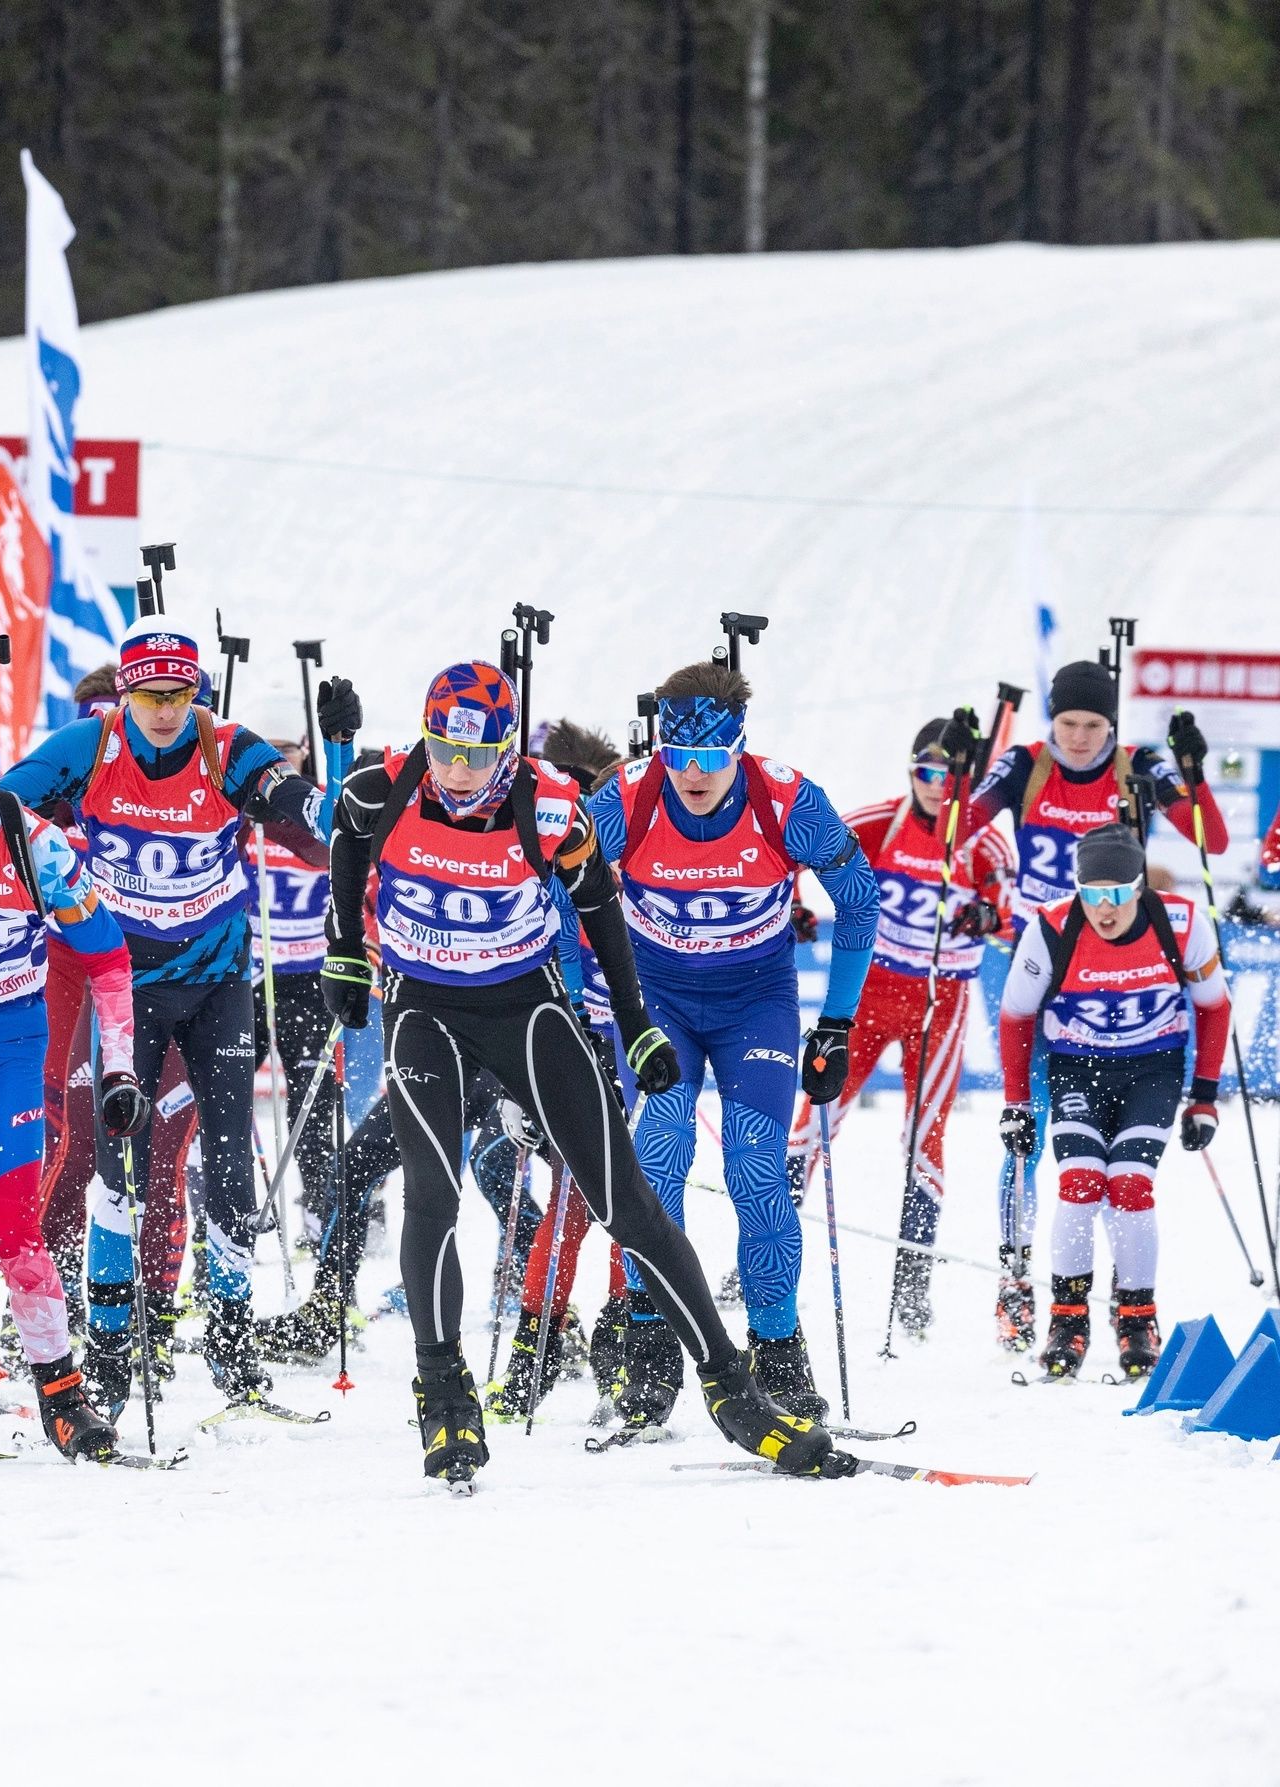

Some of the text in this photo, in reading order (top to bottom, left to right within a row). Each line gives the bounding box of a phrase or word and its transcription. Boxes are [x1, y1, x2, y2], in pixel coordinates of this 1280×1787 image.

[111, 796, 193, 822] Severstal
[537, 811, 567, 827] VEKA
[95, 830, 224, 880] 206
[408, 846, 509, 878] Severstal
[1030, 834, 1078, 881] 21
[113, 869, 148, 893] RYBU
[652, 861, 744, 881] Severstal
[257, 874, 321, 912] 17
[168, 908, 180, 918] &
[410, 921, 452, 948] RYBU
[674, 937, 710, 951] CUP
[1078, 962, 1169, 984] Северсталь
[216, 1047, 256, 1057] NORDS
[743, 1049, 796, 1068] KV+
[67, 1078, 94, 1087] adida
[12, 1108, 45, 1127] KV+
[528, 1317, 539, 1332] 8
